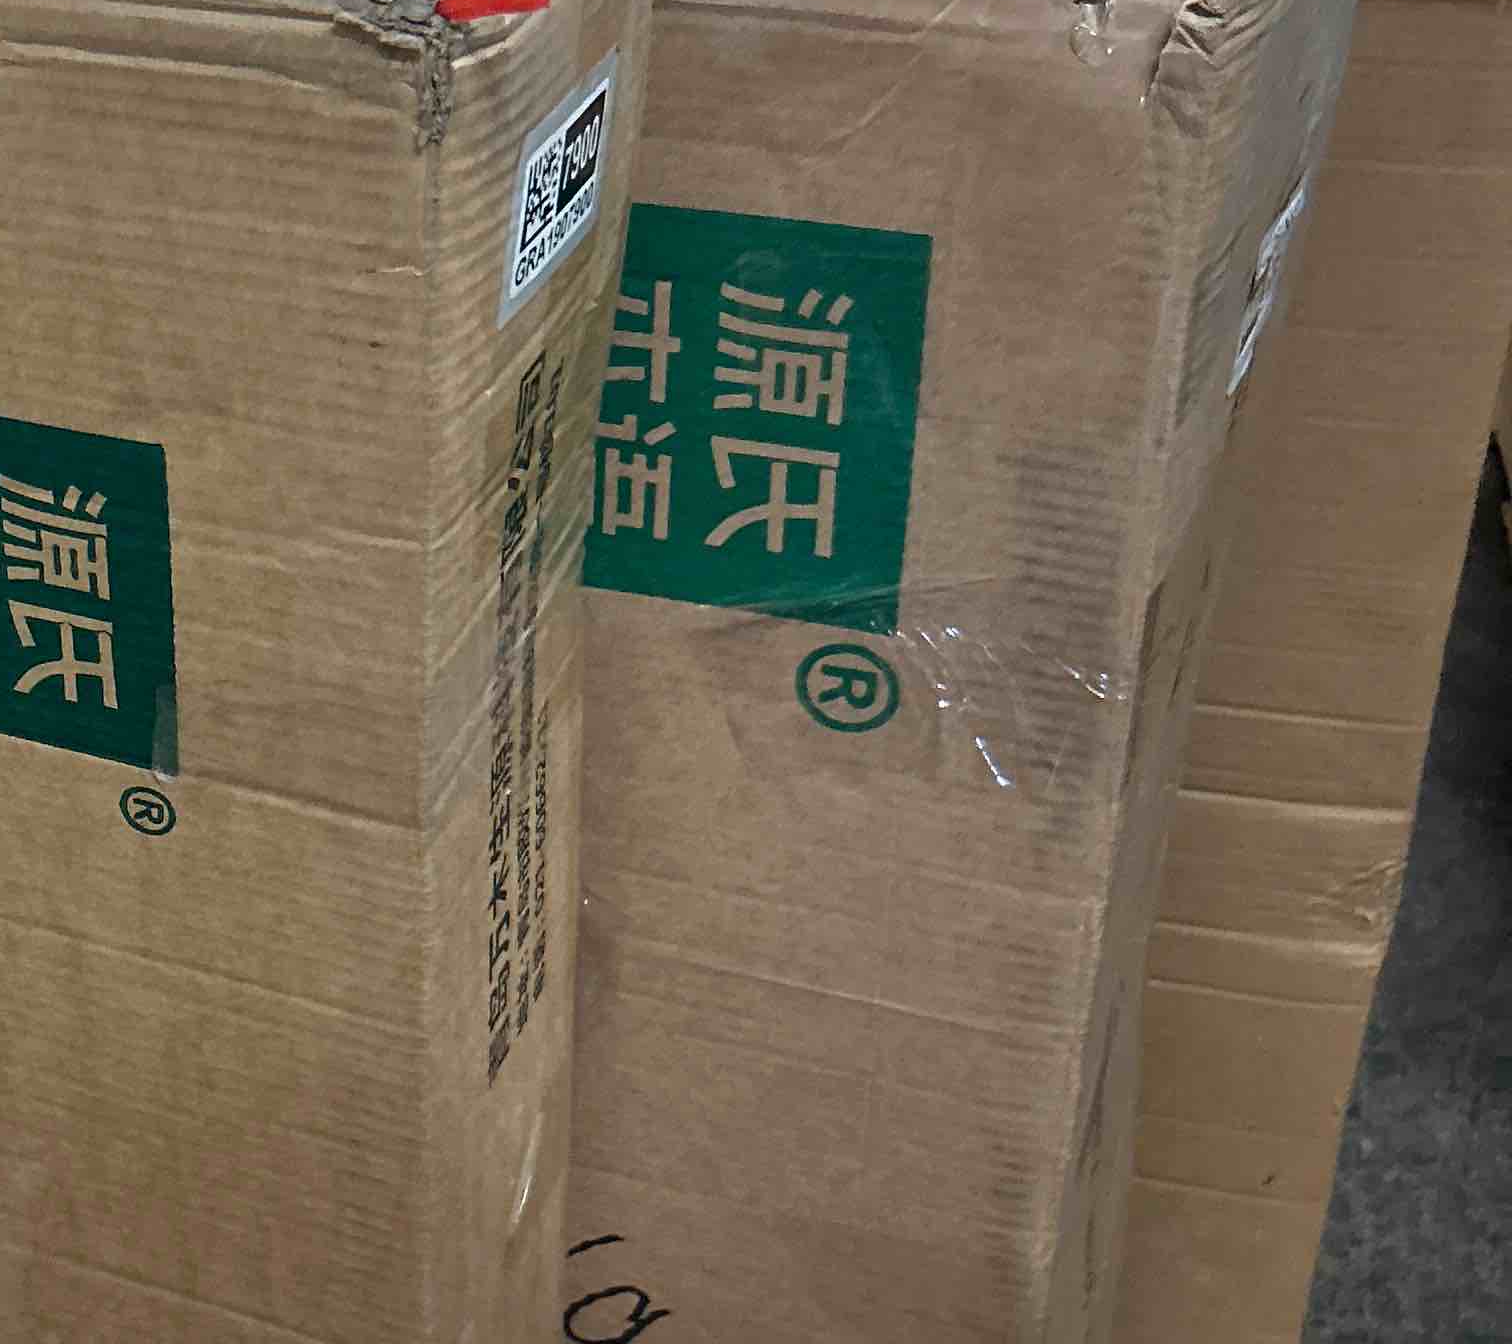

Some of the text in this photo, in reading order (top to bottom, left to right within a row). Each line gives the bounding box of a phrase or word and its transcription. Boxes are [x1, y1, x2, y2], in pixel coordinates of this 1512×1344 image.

[561, 114, 601, 191] 7900
[514, 181, 595, 288] GRA1907900
[703, 280, 854, 559] 源氏
